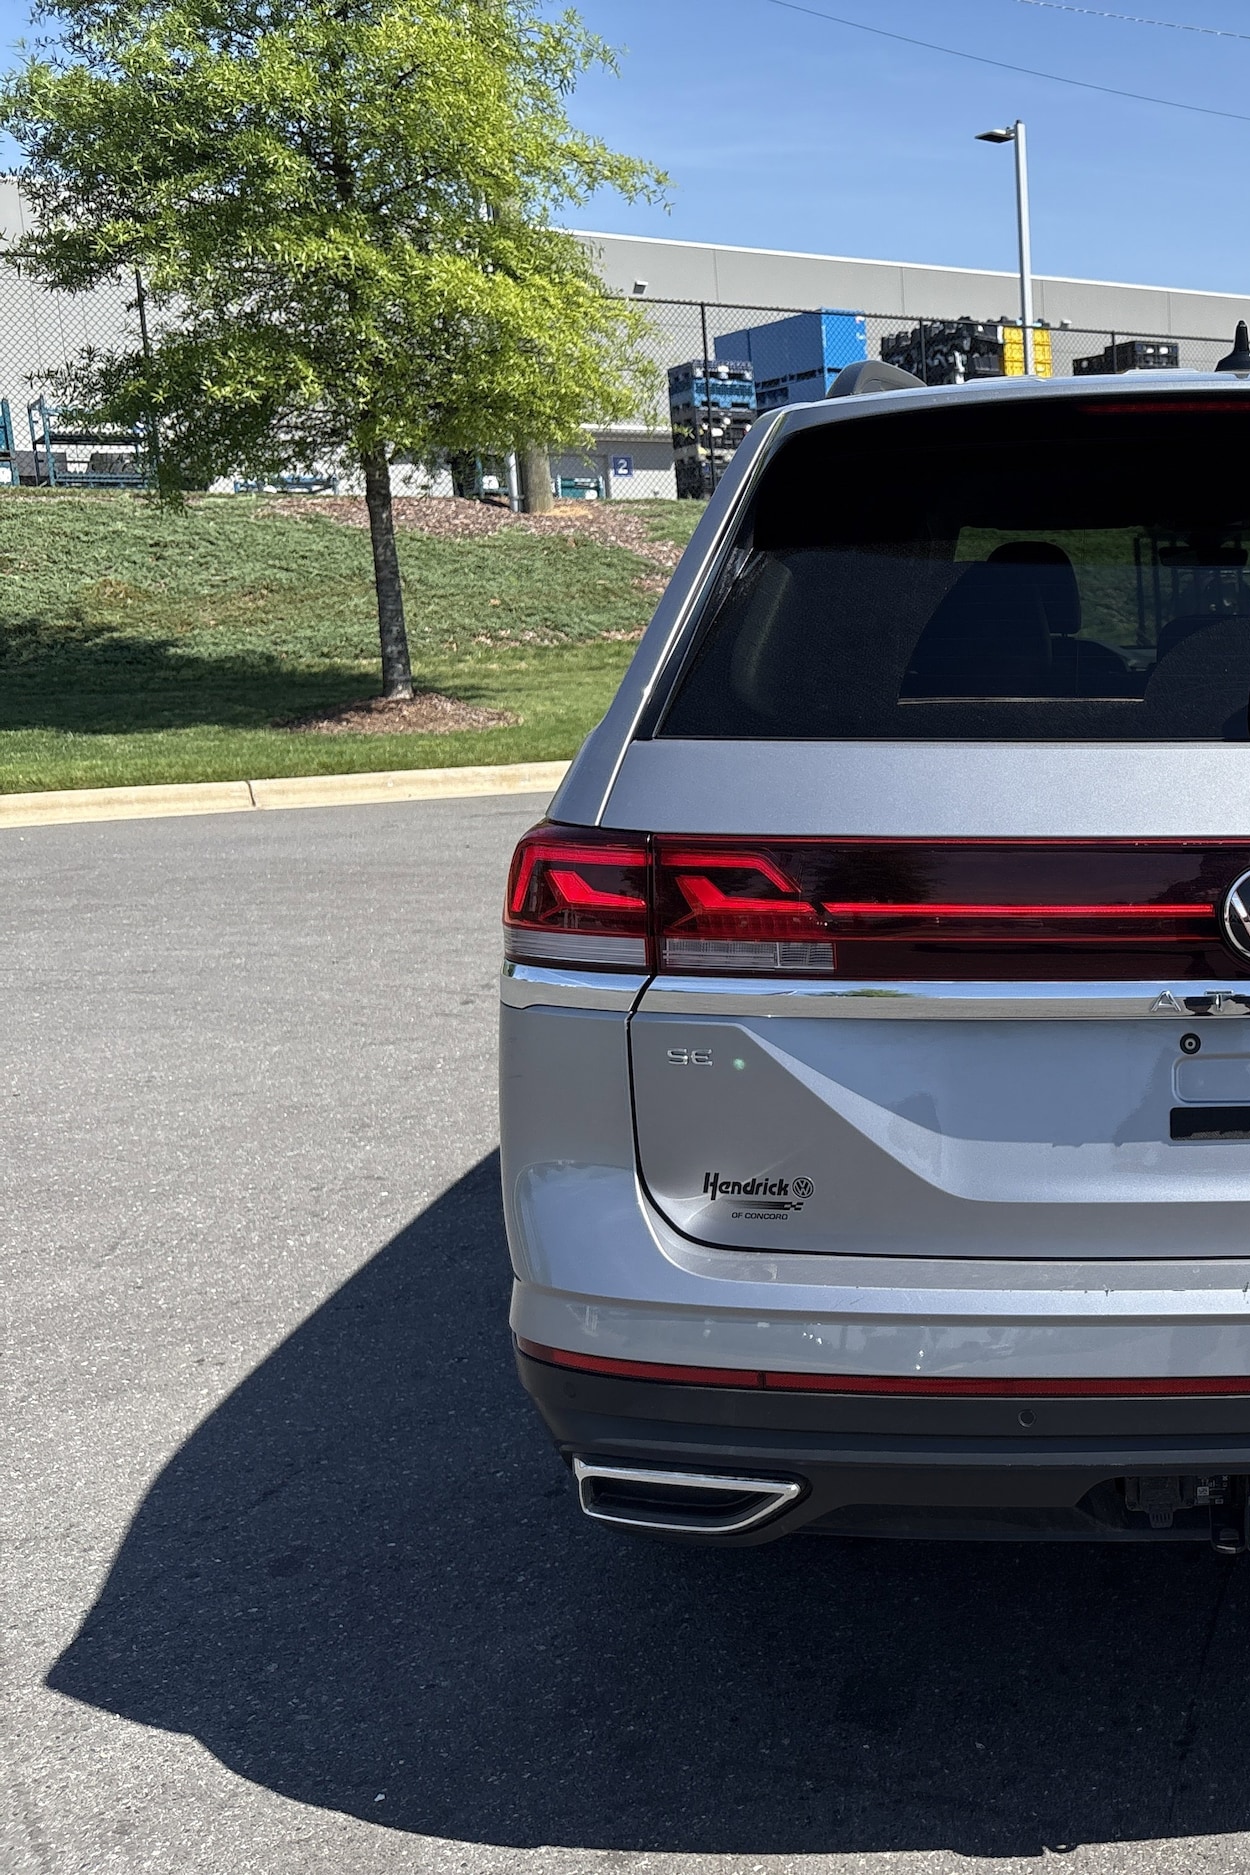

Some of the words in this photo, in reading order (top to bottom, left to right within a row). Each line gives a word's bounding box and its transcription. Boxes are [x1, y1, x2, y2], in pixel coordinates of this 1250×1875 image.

[617, 458, 629, 475] 2
[667, 1048, 713, 1066] SE
[702, 1171, 791, 1201] Hendrick
[744, 1212, 788, 1220] CONCORD
